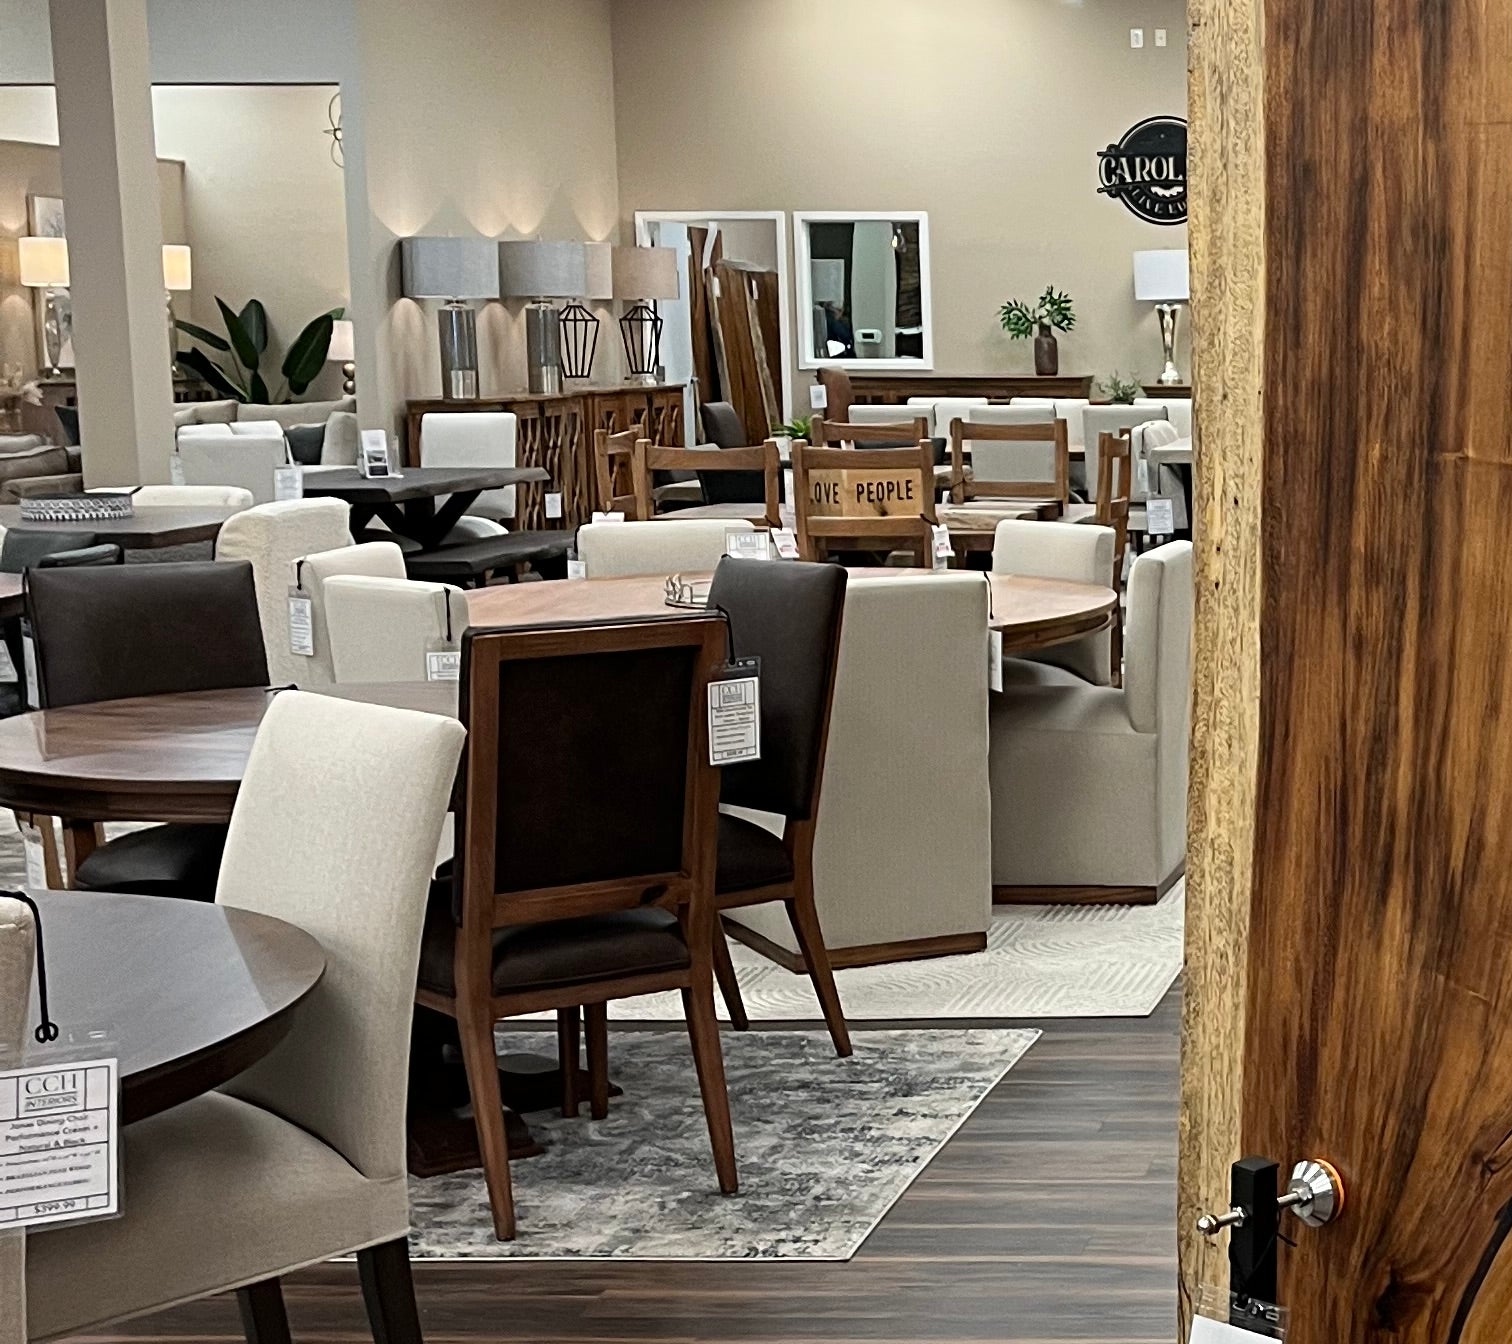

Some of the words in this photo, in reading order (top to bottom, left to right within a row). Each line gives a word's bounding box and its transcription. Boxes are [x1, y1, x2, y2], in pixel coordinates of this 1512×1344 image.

[1100, 156, 1187, 186] CAROL
[811, 481, 840, 504] OVE
[856, 479, 914, 504] PEOPLE
[25, 1073, 77, 1095] CCH
